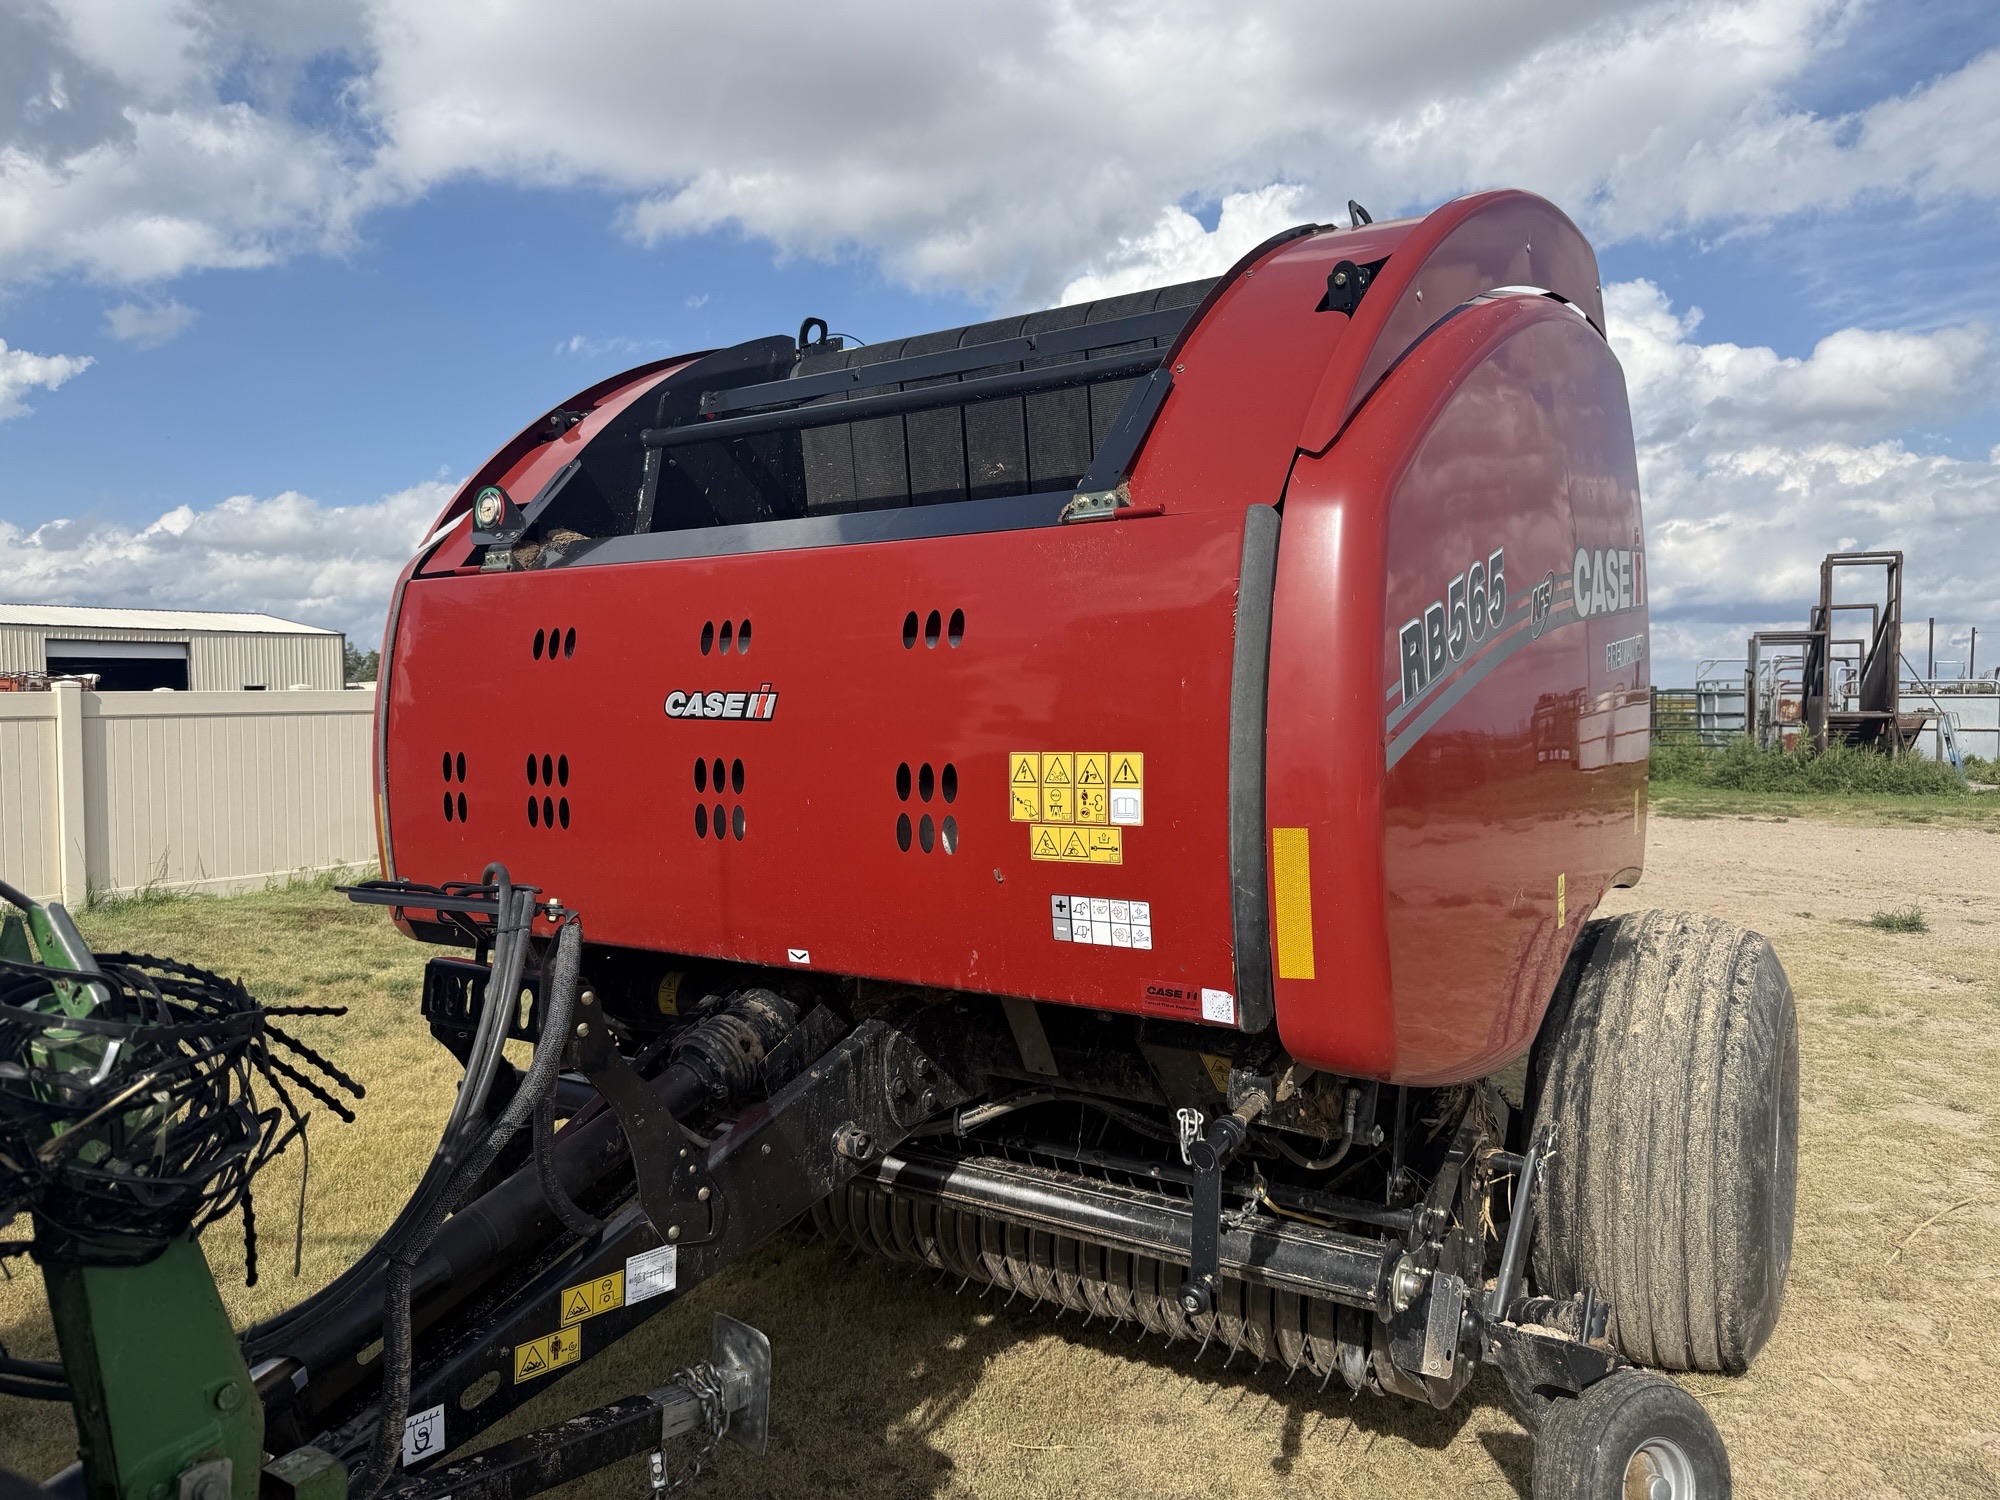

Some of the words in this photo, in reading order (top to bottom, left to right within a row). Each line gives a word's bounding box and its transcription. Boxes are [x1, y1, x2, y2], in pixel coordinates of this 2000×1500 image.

[1573, 548, 1630, 617] CASE
[1398, 546, 1506, 709] RB565
[664, 690, 747, 719] CASE
[1146, 986, 1183, 998] CASE
